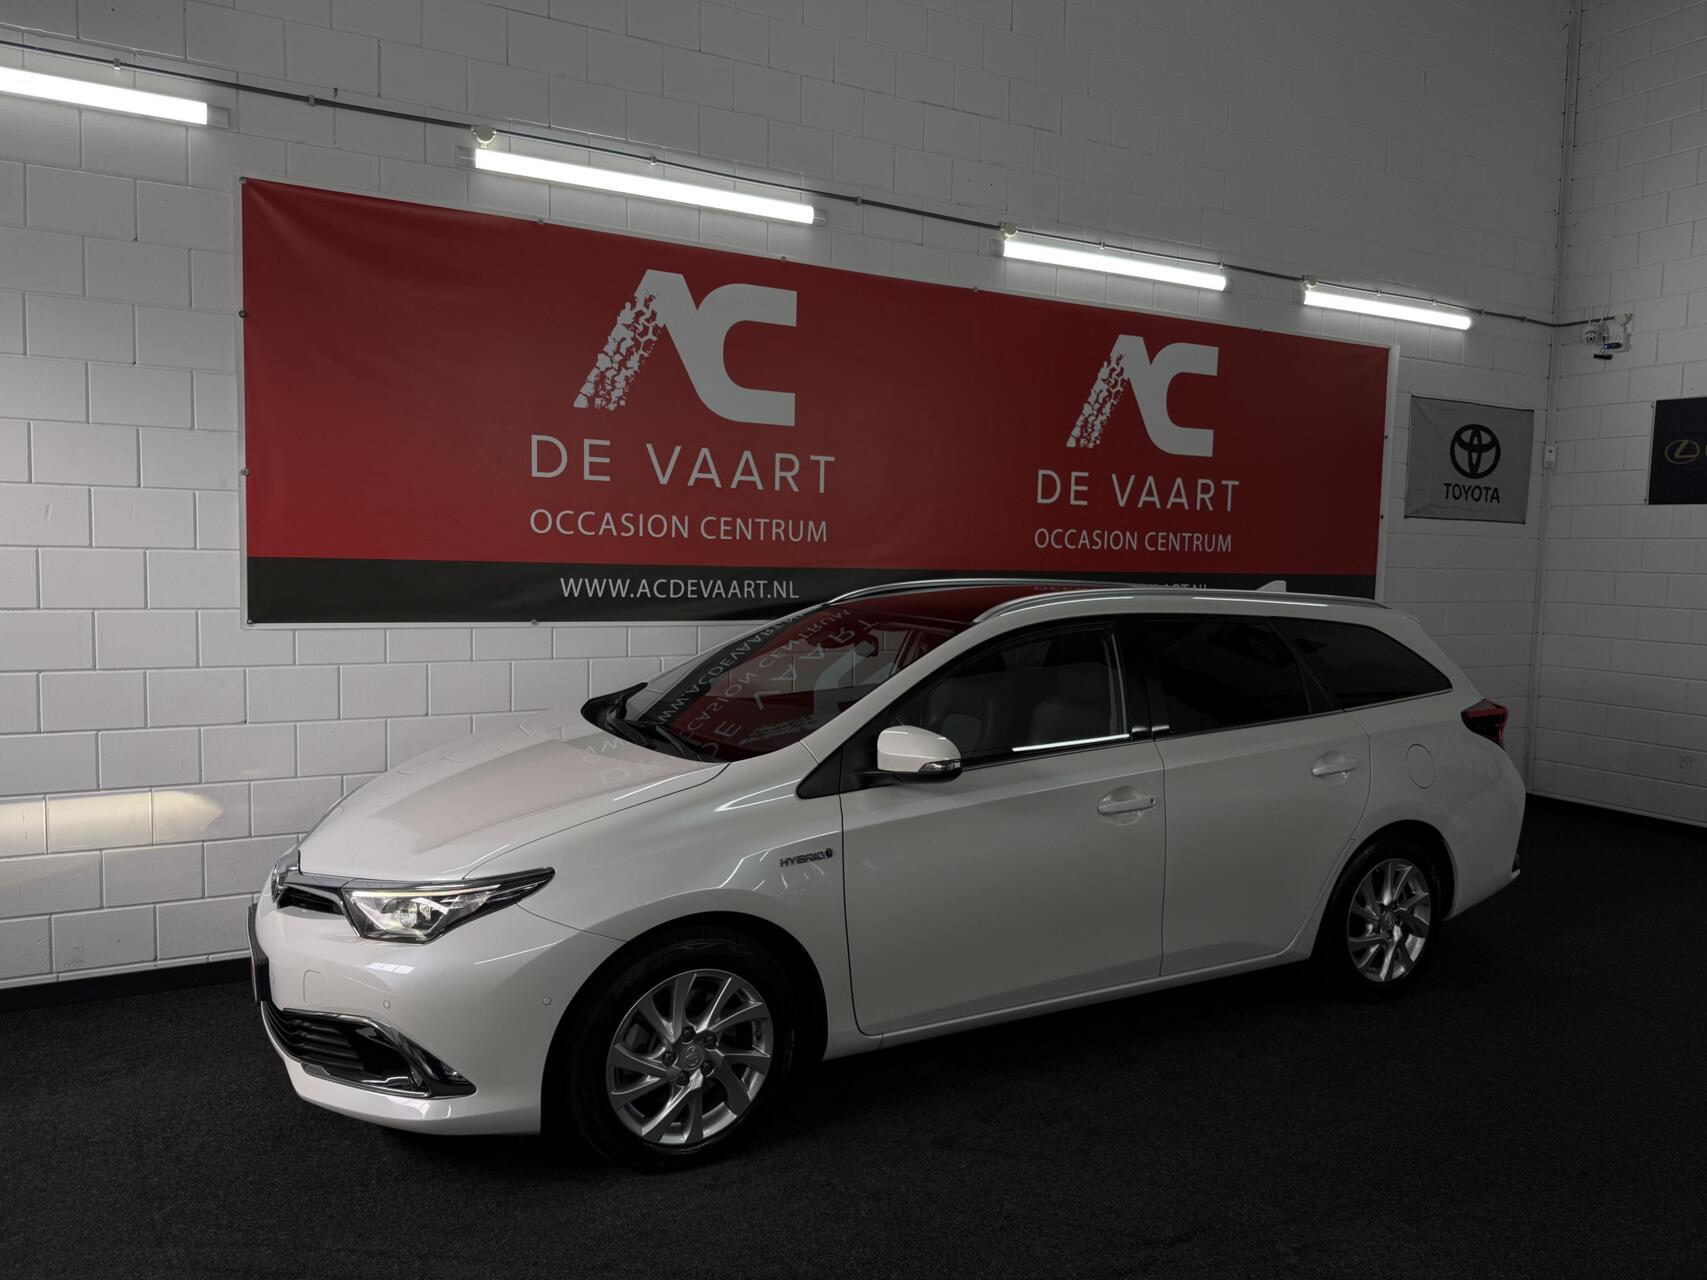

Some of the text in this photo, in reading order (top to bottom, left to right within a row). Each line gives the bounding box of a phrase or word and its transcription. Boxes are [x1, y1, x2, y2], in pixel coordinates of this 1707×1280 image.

[573, 269, 797, 427] AC
[1066, 334, 1219, 457] AC
[530, 434, 836, 494] DE VAART
[1036, 469, 1240, 512] DE VAART
[1443, 482, 1500, 503] TOYOTA
[529, 508, 828, 543] OCCASION CENTRUM
[1034, 528, 1232, 553] OCCASION CENTRUM
[559, 577, 800, 599] WWW.ACDEVAART.NL
[780, 851, 826, 867] HYBRID
